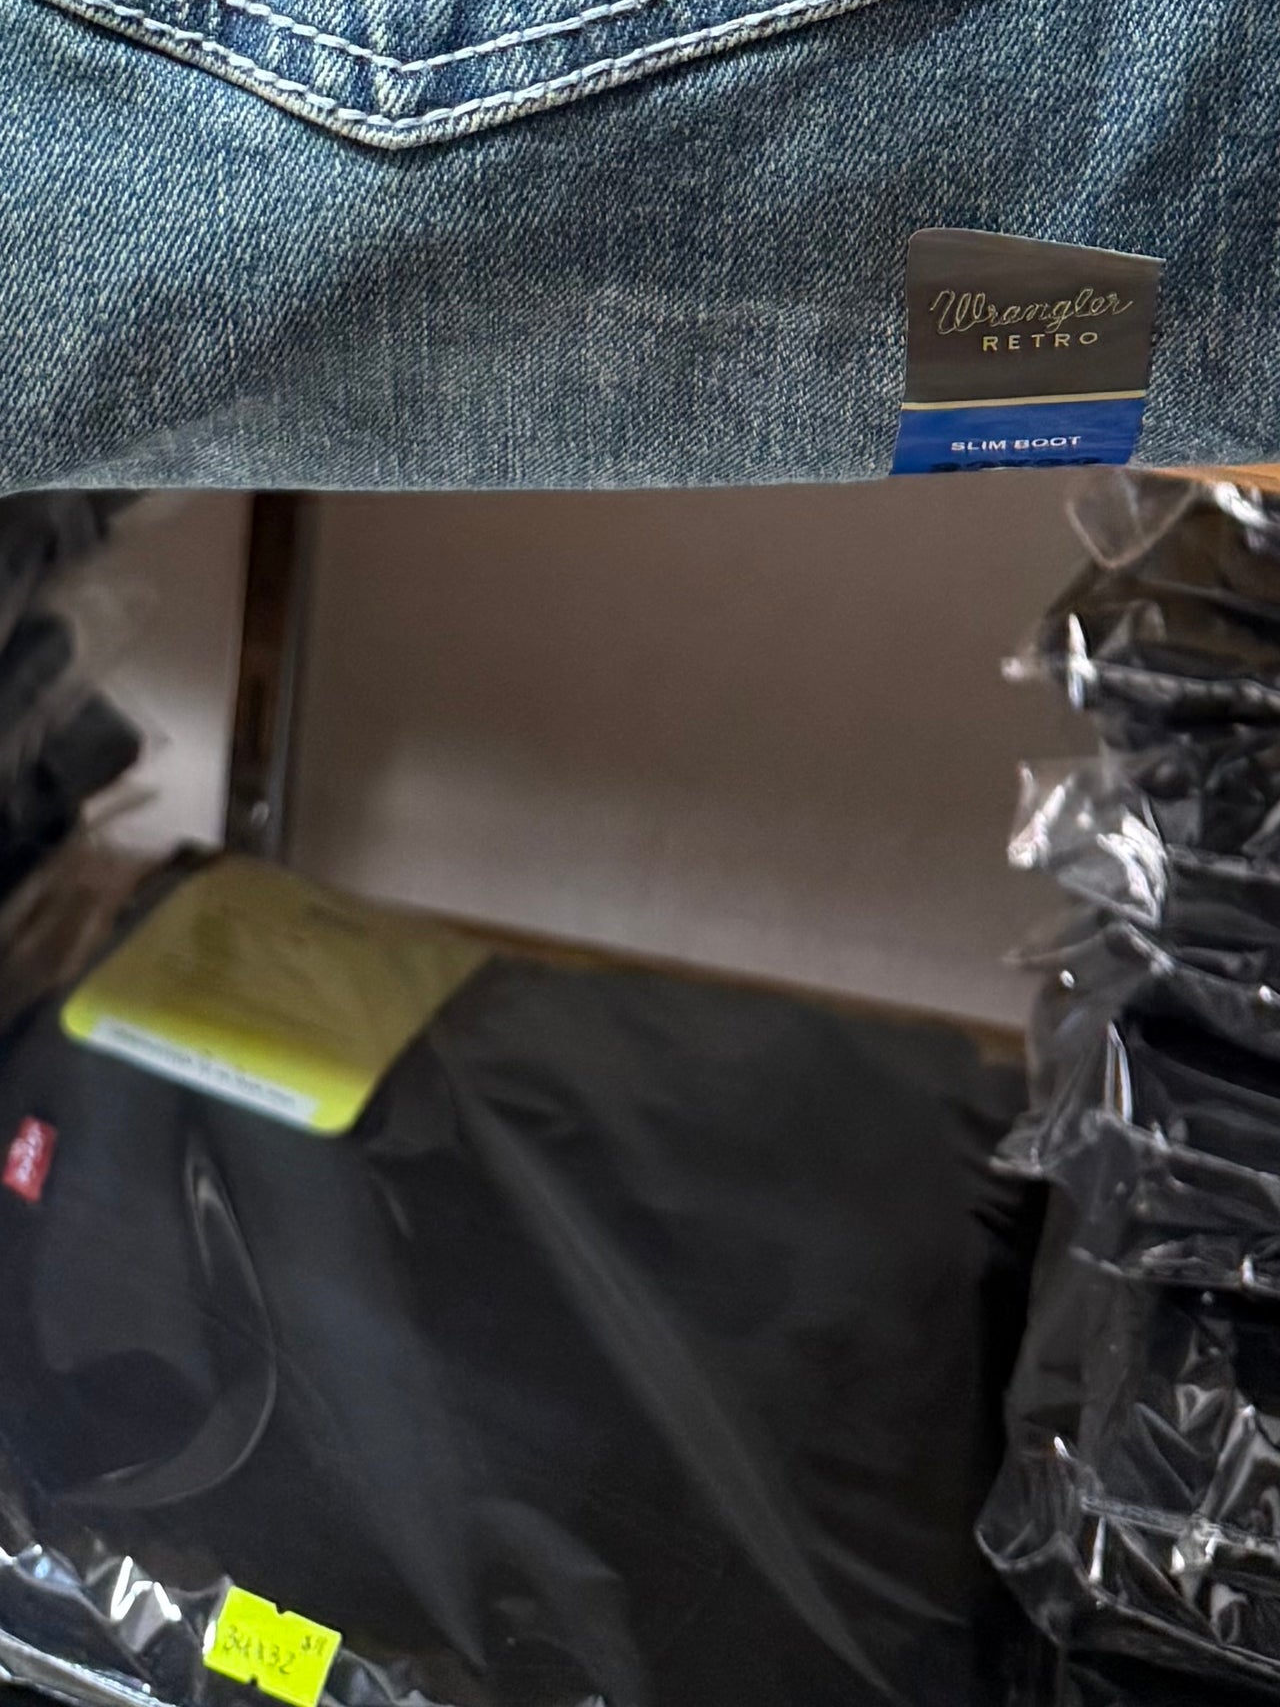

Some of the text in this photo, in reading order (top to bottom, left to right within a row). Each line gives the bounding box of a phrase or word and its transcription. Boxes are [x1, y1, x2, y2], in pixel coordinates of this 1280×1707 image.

[928, 287, 1135, 336] Wrangler
[982, 331, 1100, 353] RETRO
[950, 435, 1083, 453] SLIM BOOT
